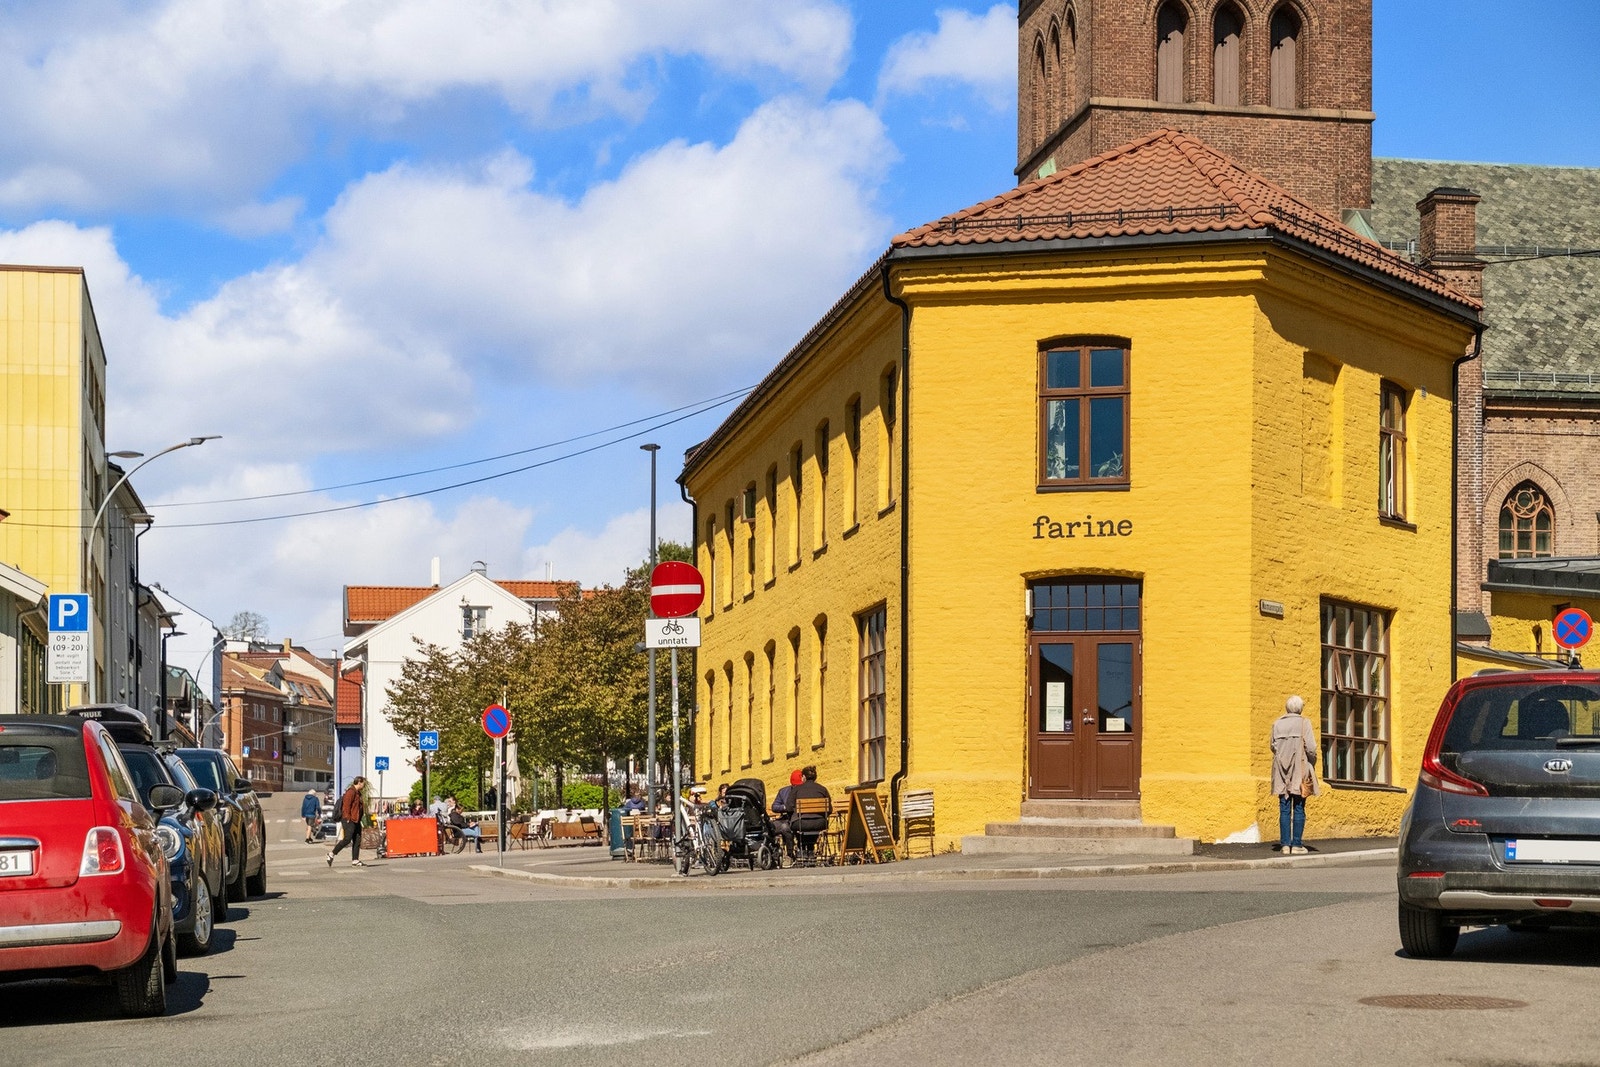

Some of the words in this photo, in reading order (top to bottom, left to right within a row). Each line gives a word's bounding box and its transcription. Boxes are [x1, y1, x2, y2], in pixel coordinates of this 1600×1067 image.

[1032, 514, 1133, 540] farine
[58, 599, 79, 627] P
[657, 637, 688, 645] unntatt
[1548, 761, 1568, 770] KIA
